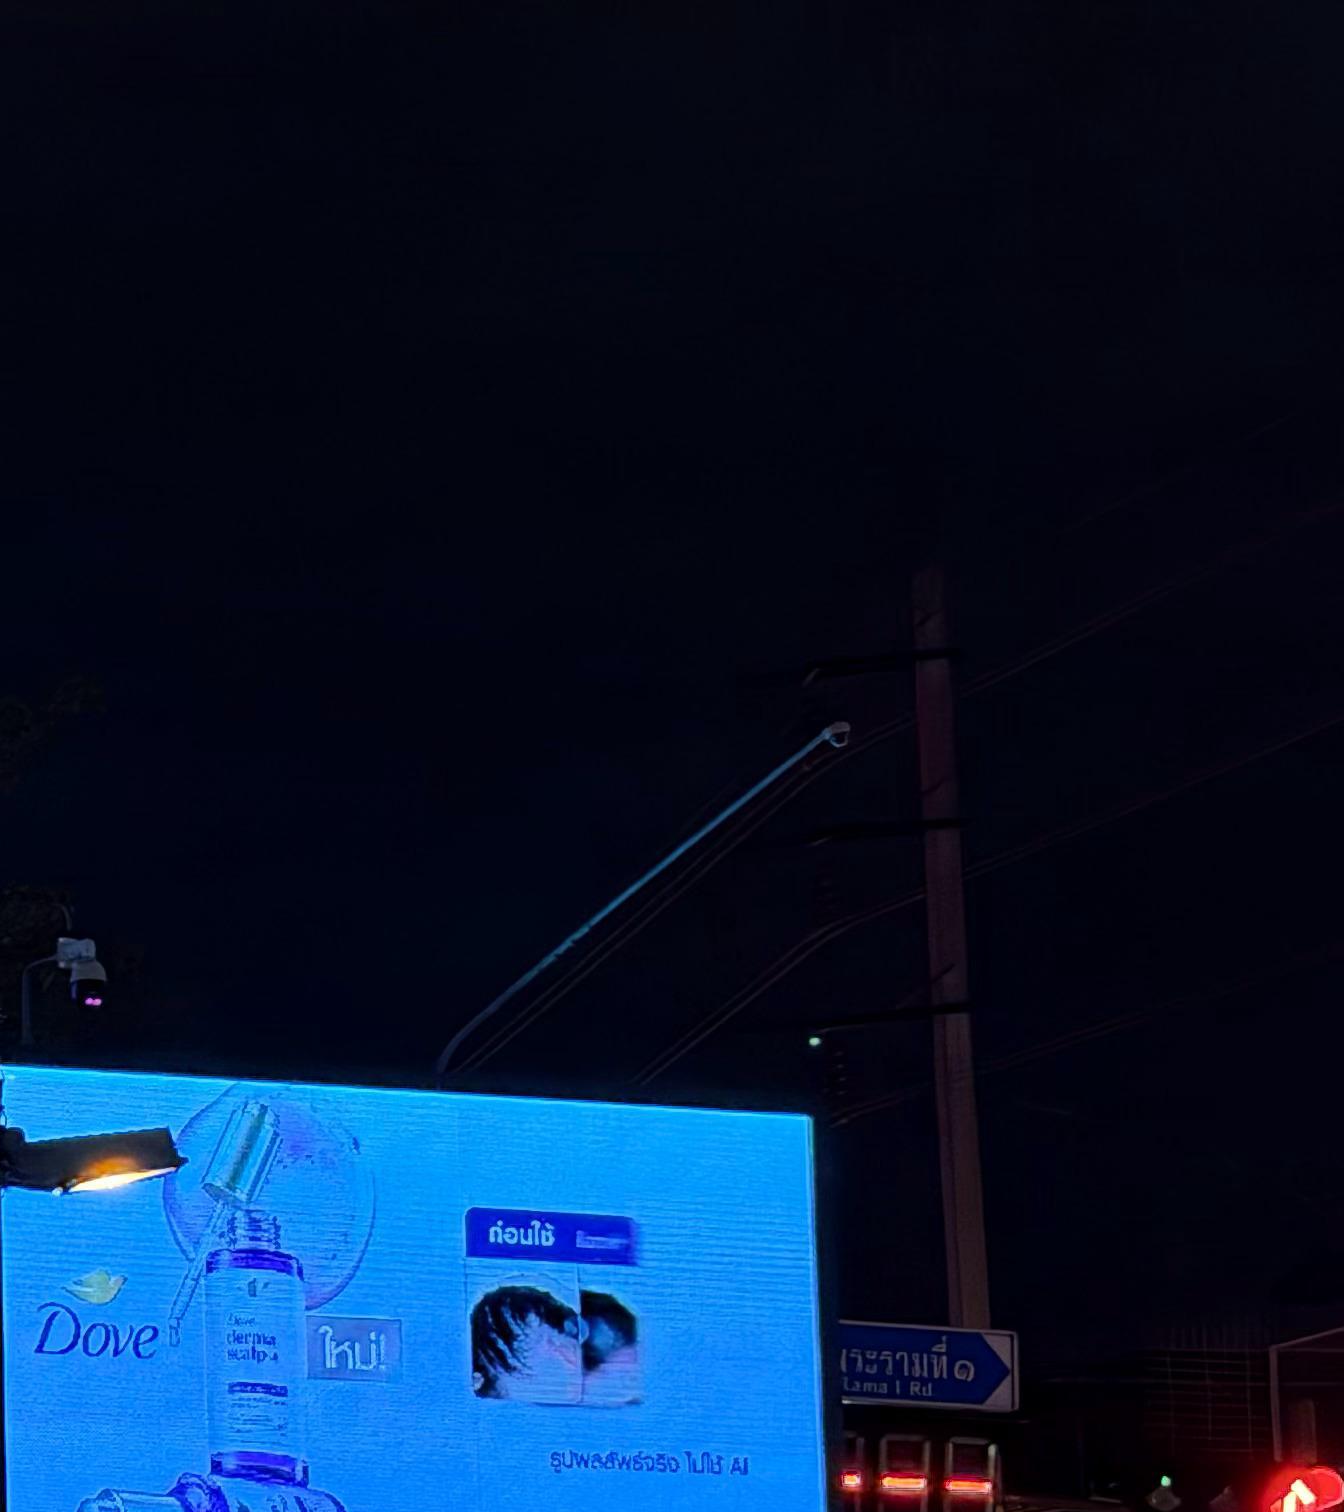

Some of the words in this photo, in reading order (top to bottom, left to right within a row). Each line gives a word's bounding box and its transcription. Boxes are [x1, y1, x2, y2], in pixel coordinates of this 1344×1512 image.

[34, 1301, 159, 1359] Dove
[318, 1325, 386, 1371] ใหม่!
[910, 1381, 933, 1397] Rd
